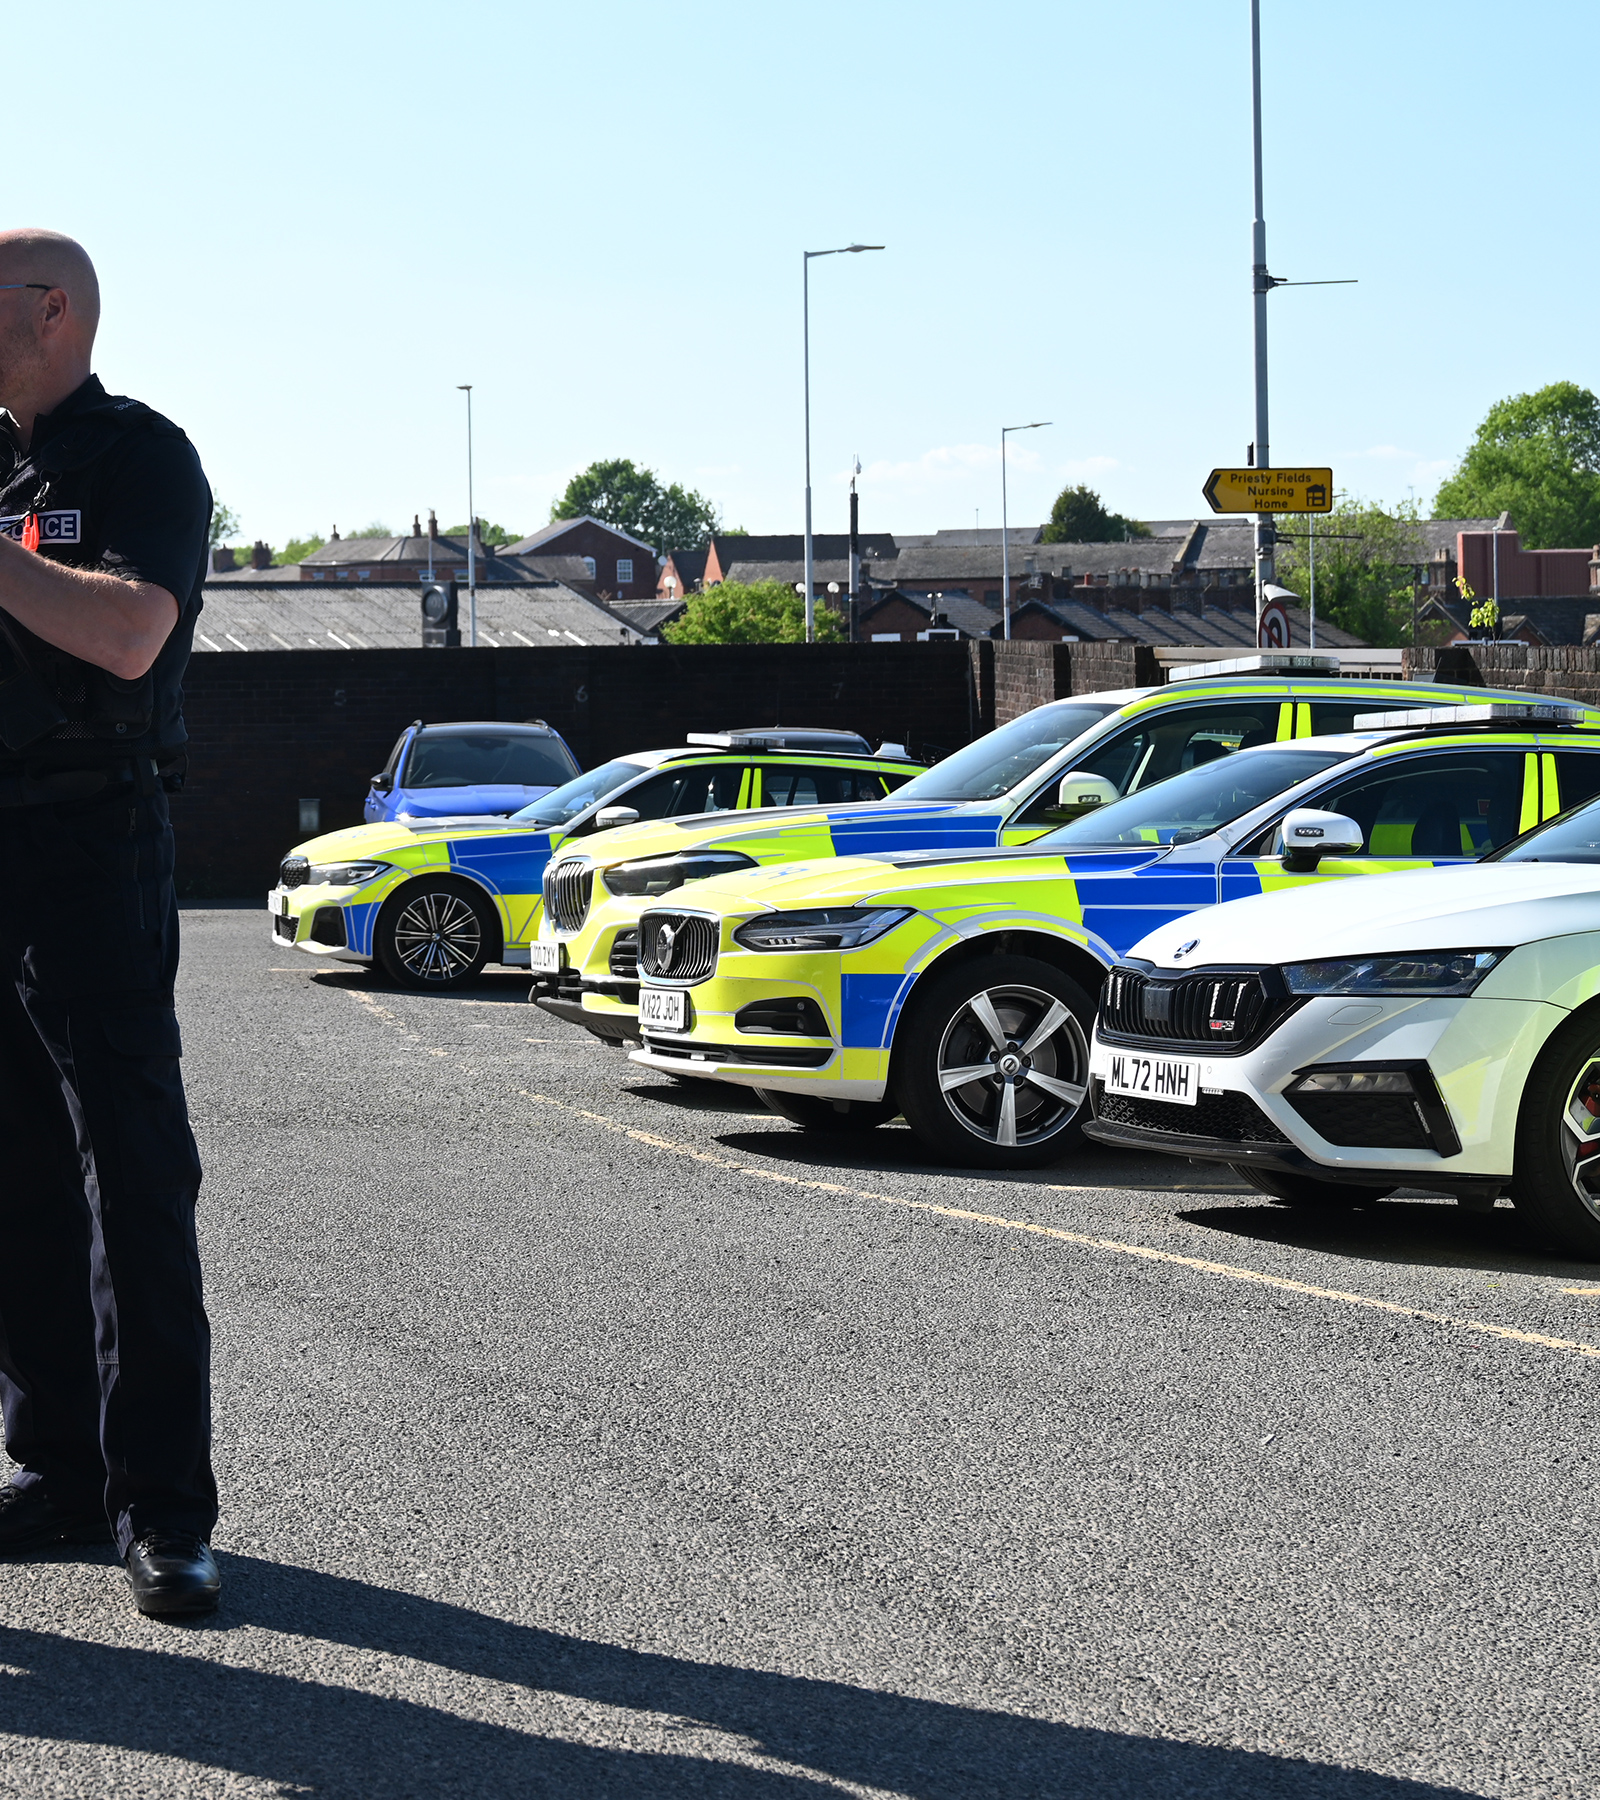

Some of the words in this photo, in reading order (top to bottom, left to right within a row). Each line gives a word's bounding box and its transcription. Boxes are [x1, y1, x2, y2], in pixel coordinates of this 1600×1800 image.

[1230, 473, 1272, 484] Priesty
[1276, 472, 1312, 483] Fields
[1247, 486, 1295, 497] Nursing
[1254, 499, 1288, 509] Home
[0, 516, 75, 540] POICE
[333, 688, 348, 707] 5
[576, 685, 589, 703] 6
[641, 993, 662, 1020] KX22
[1111, 1056, 1151, 1092] ML72
[1154, 1061, 1190, 1097] HNH
